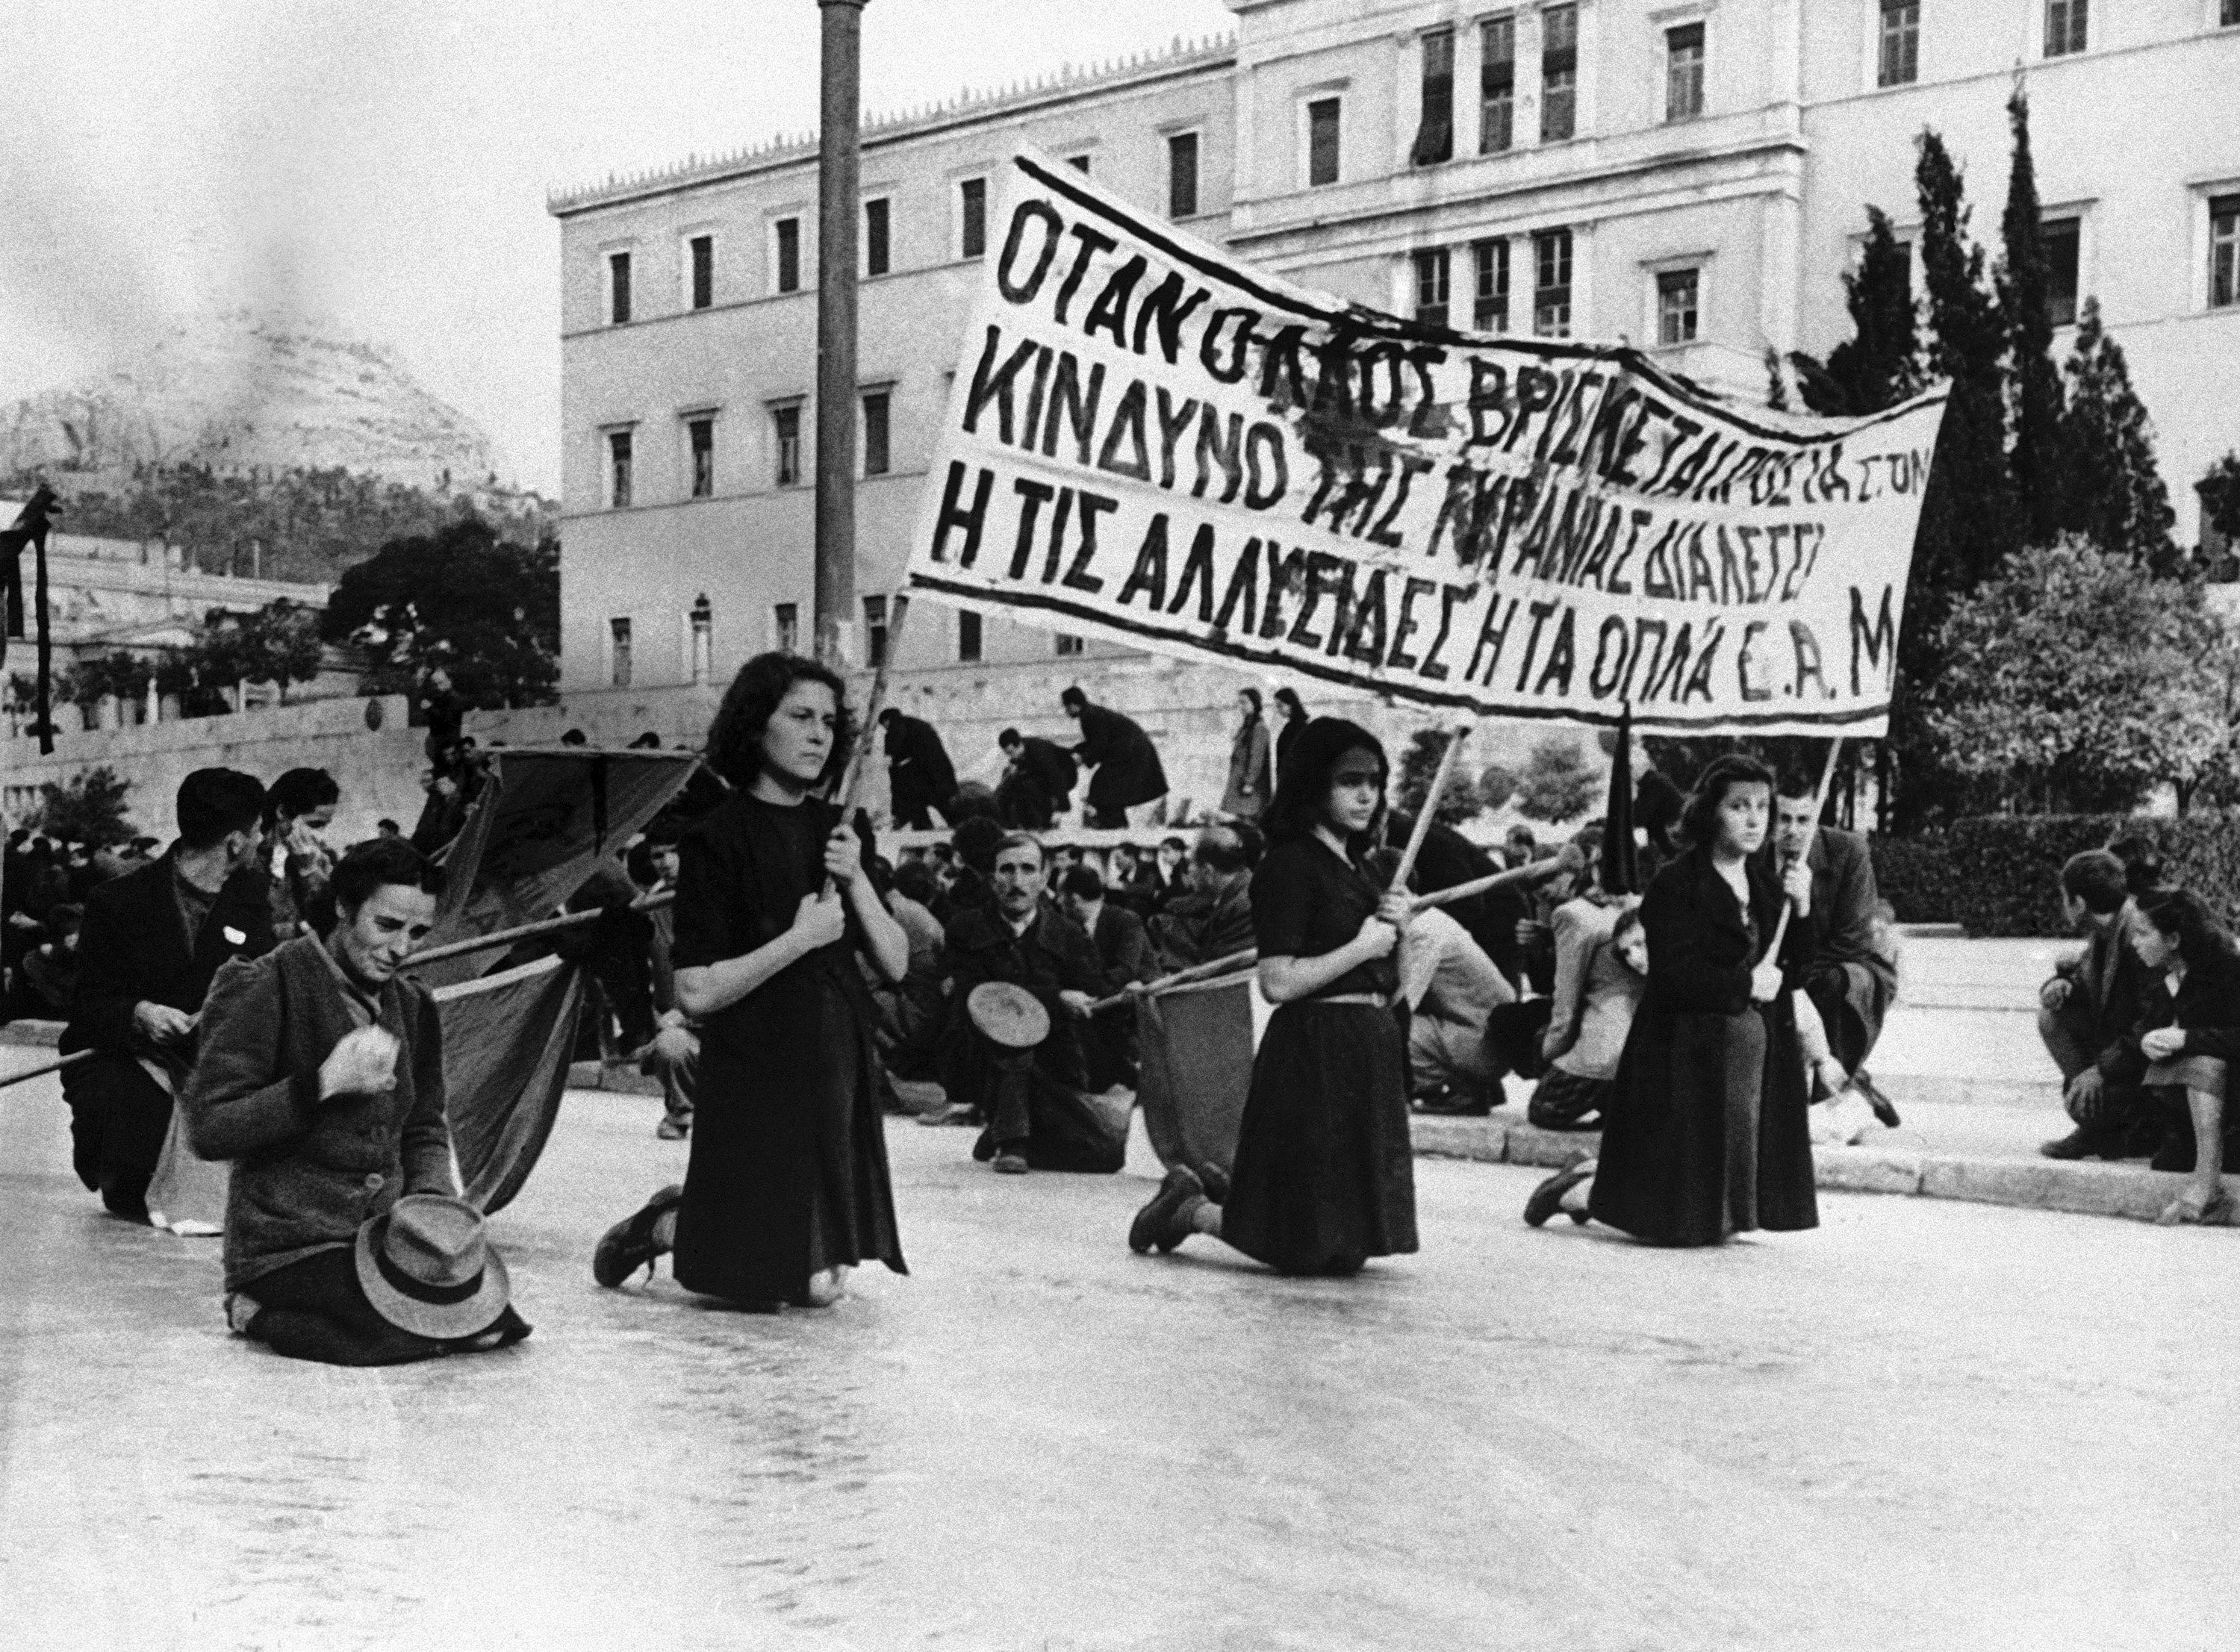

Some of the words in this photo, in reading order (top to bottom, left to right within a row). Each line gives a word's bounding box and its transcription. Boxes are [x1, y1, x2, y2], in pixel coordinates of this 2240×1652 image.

[998, 199, 1210, 365] ΟΤΑΝ
[963, 325, 1287, 511] ΚΙΝΔΥΝΟ
[932, 460, 994, 569] Η
[1009, 478, 1119, 593] ΤΙΣ
[1466, 593, 1520, 687] Η
